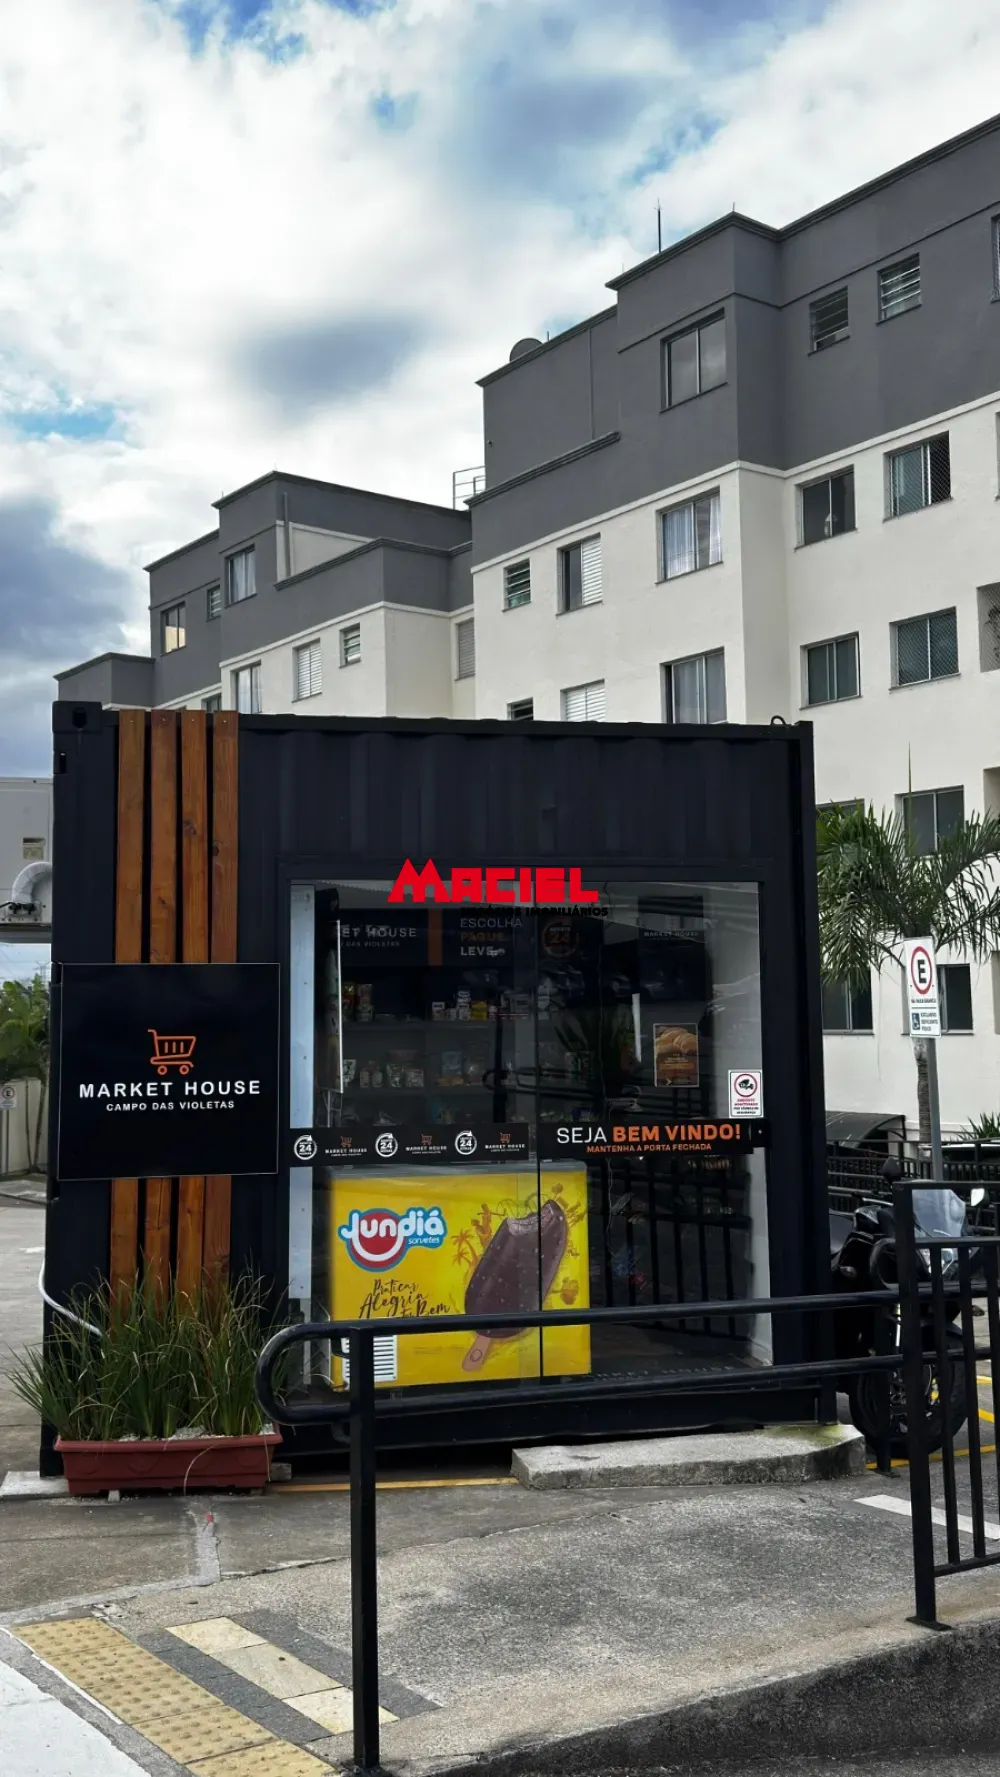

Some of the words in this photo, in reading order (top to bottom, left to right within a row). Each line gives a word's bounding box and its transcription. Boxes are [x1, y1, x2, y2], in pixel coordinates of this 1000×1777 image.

[459, 917, 523, 929] ESCOLHA
[367, 926, 418, 938] HOUSE
[917, 959, 928, 984] E
[79, 1082, 173, 1098] MARKET
[184, 1080, 261, 1096] HOUSE
[106, 1102, 148, 1112] CAMPO
[152, 1101, 175, 1111] DAS
[179, 1100, 236, 1110] VIOLETAS
[556, 1127, 608, 1144] SEJA
[612, 1125, 660, 1143] BEM
[664, 1123, 742, 1141] VINDO!
[299, 1144, 312, 1152] 24
[380, 1142, 393, 1150] 24
[460, 1139, 473, 1147] 24
[586, 1145, 635, 1154] MANTENHA
[643, 1144, 671, 1152] PORTA
[672, 1143, 712, 1151] FECHADA
[340, 1208, 445, 1245] Jundiá
[407, 1236, 440, 1245] sorvetes
[373, 1279, 419, 1296] Praticar
[358, 1291, 427, 1319] Alegria
